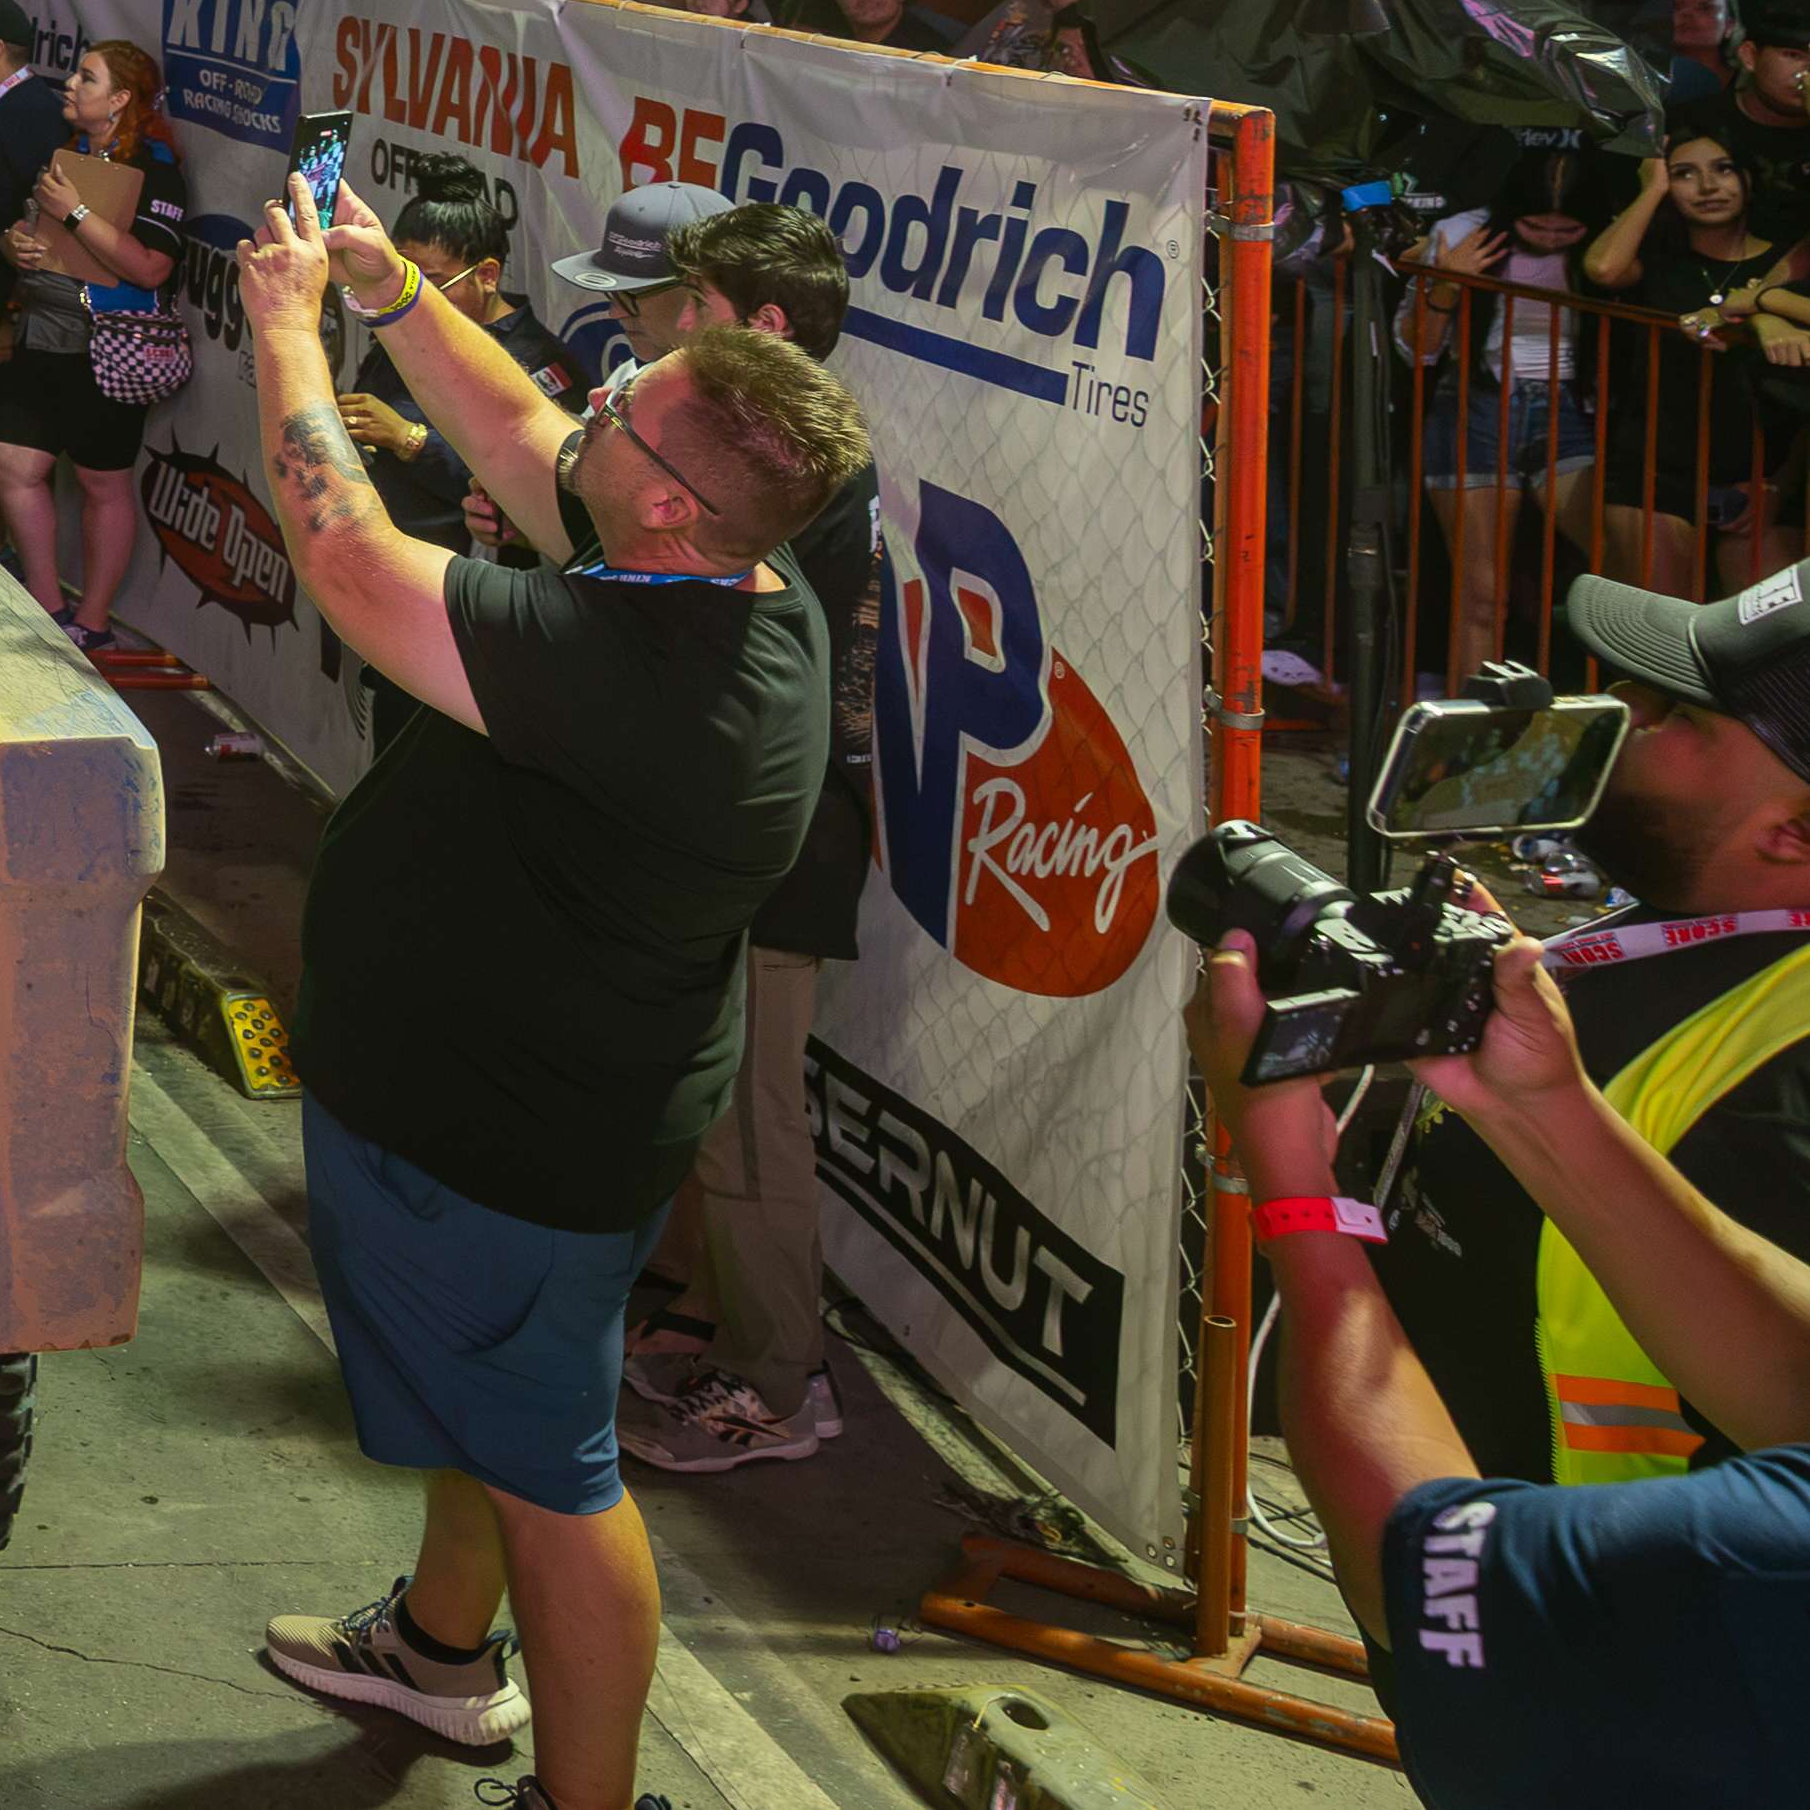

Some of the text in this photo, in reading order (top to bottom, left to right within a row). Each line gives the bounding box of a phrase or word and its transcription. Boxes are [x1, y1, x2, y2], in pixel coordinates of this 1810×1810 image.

[333, 16, 580, 179] SYLVANIA
[1071, 360, 1150, 428] Tires
[150, 459, 290, 604] Wide Open
[964, 776, 1160, 934] Racing
[1420, 1500, 1498, 1670] STAFF
